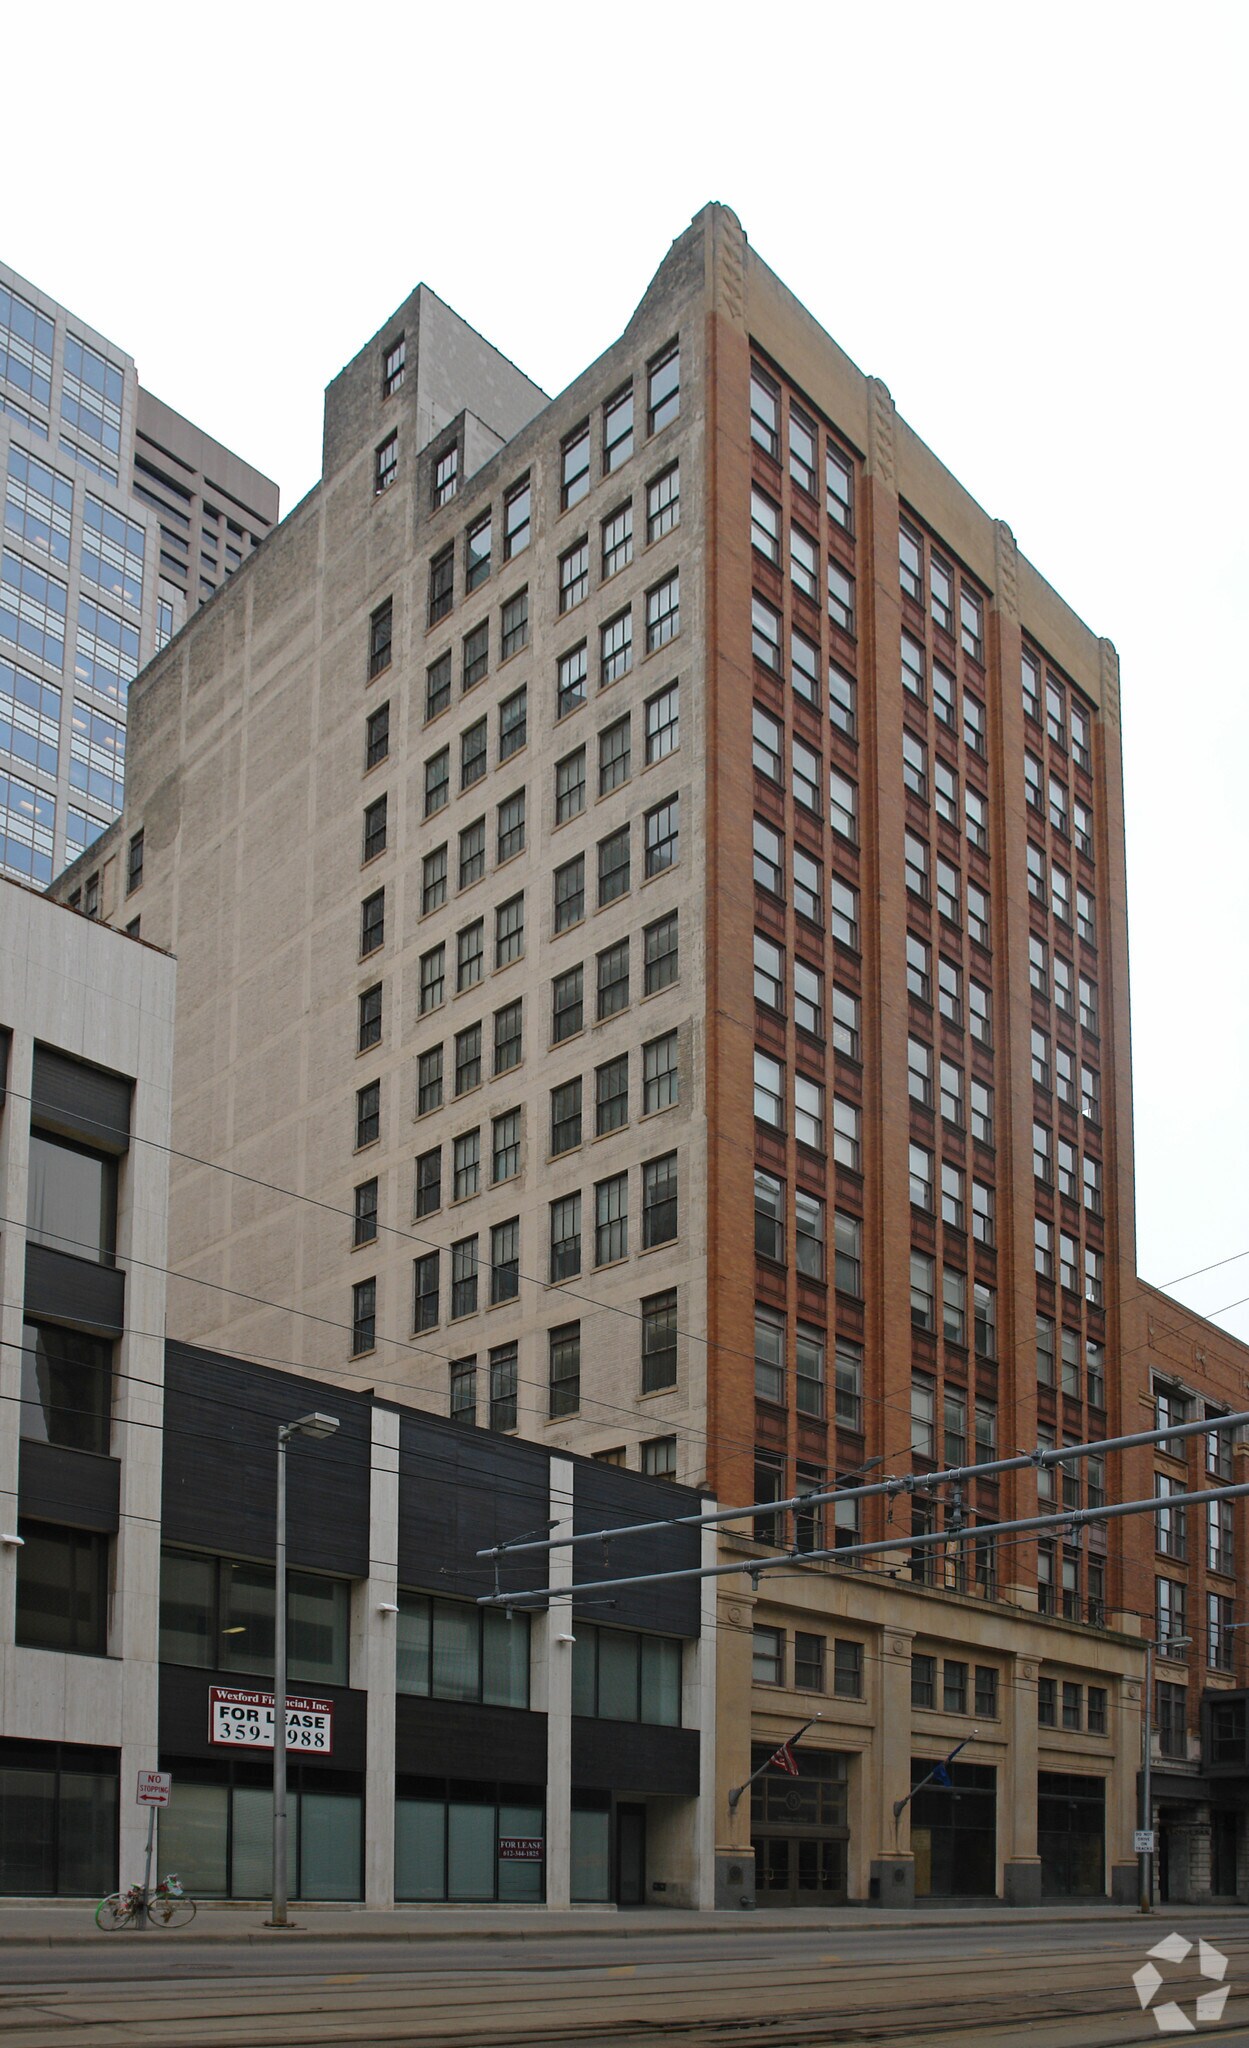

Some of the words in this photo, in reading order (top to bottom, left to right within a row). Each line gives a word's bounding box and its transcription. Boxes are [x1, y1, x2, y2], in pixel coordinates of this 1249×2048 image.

[216, 1690, 259, 1703] Wexford
[312, 1701, 330, 1711] Inc.
[220, 1706, 259, 1722] FOR
[266, 1711, 325, 1729] LASE
[220, 1722, 325, 1748] 359-988
[140, 1785, 168, 1793] STOPPING
[148, 1775, 162, 1783] NO
